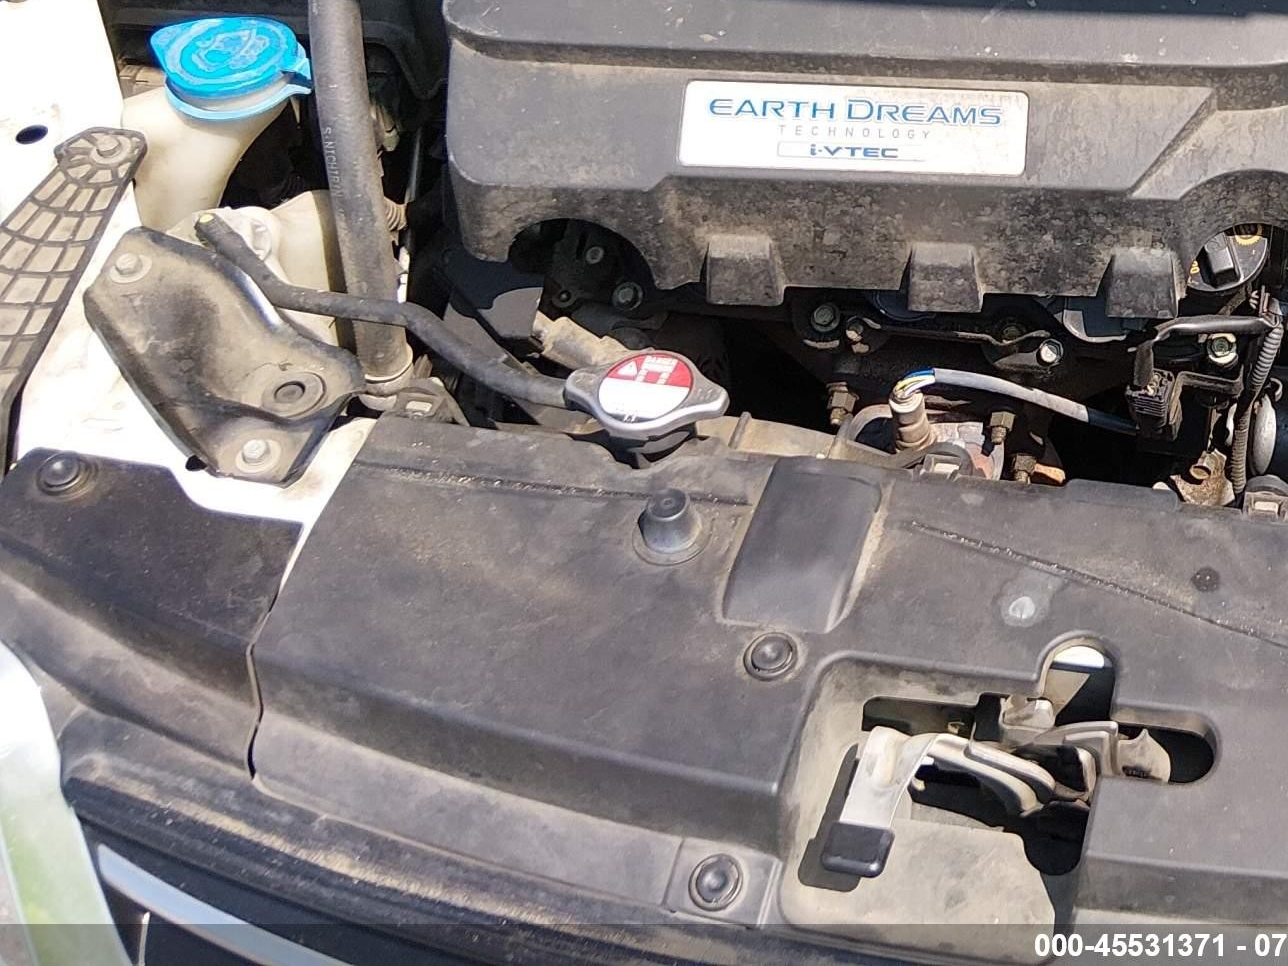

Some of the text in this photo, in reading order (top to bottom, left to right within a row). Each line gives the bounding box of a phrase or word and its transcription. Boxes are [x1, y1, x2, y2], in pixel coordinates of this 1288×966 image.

[709, 98, 835, 120] EARTH
[778, 125, 931, 139] TECHNOLOGY
[810, 144, 898, 159] i-VTEC
